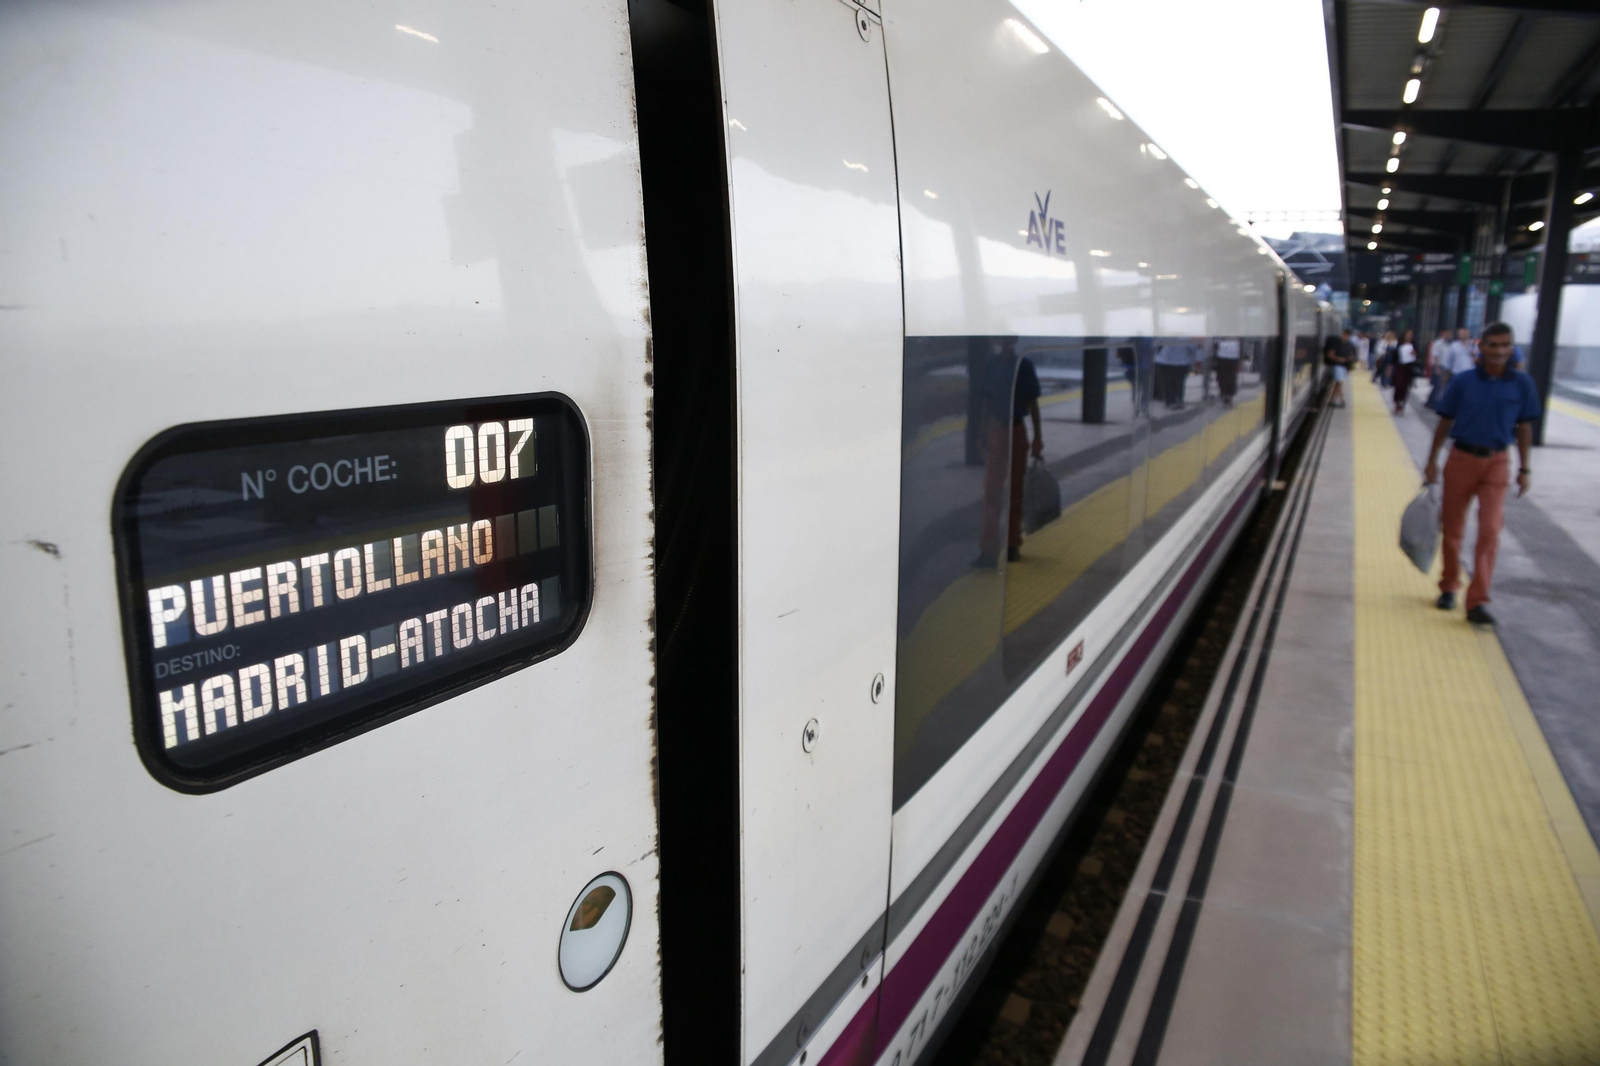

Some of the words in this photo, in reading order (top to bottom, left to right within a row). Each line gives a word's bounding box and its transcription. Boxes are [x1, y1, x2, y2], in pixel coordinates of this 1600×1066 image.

[1026, 189, 1067, 257] AVE
[287, 454, 397, 494] COCHE:
[444, 418, 534, 490] 007
[147, 518, 494, 649] PUERTOLLANO
[154, 644, 241, 679] DESTINO:
[159, 582, 541, 749] MADRID-ATOCHA
